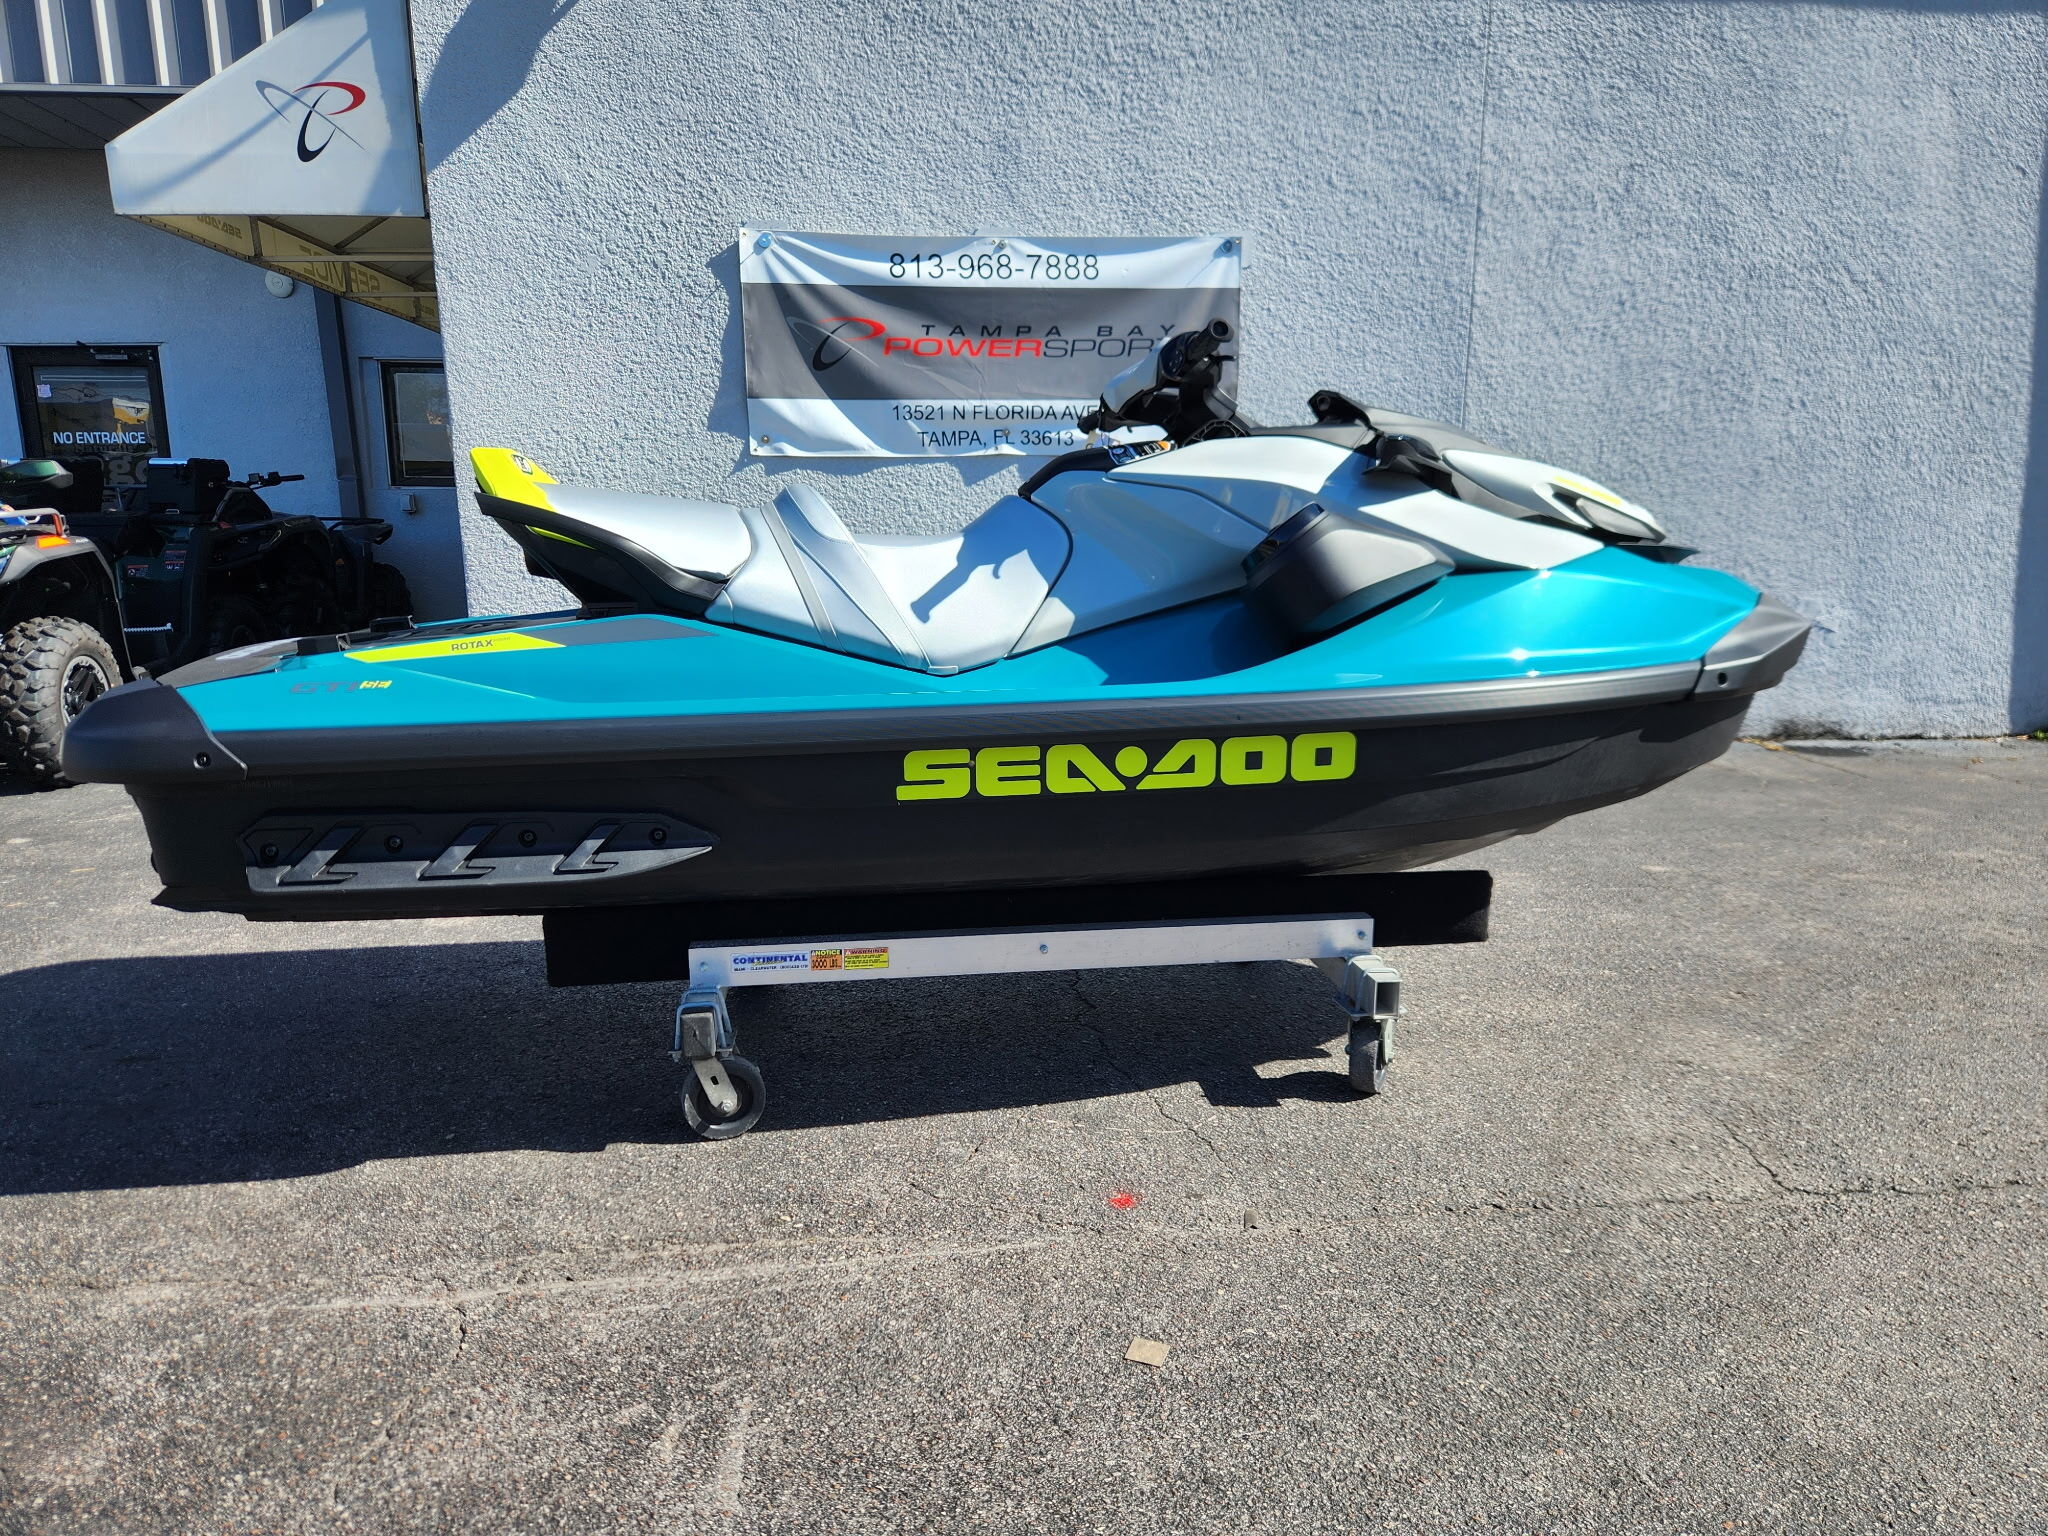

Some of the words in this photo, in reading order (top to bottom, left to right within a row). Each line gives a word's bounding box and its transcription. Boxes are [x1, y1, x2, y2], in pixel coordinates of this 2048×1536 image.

[889, 253, 1099, 280] 813-968-7888
[921, 324, 1062, 337] TAMPA
[1096, 324, 1175, 338] BAY
[883, 337, 1164, 358] POWERSPOR
[892, 404, 944, 421] 13521
[953, 405, 965, 420] N
[973, 404, 1057, 420] FLORIDA
[53, 432, 73, 444] NO
[76, 432, 146, 444] ENTRANCE
[917, 430, 987, 448] TAMPA,
[993, 429, 1015, 445] FL
[1020, 430, 1074, 446] 33613
[451, 639, 494, 651] ROTAX
[733, 954, 808, 965] CONTINENTAL
